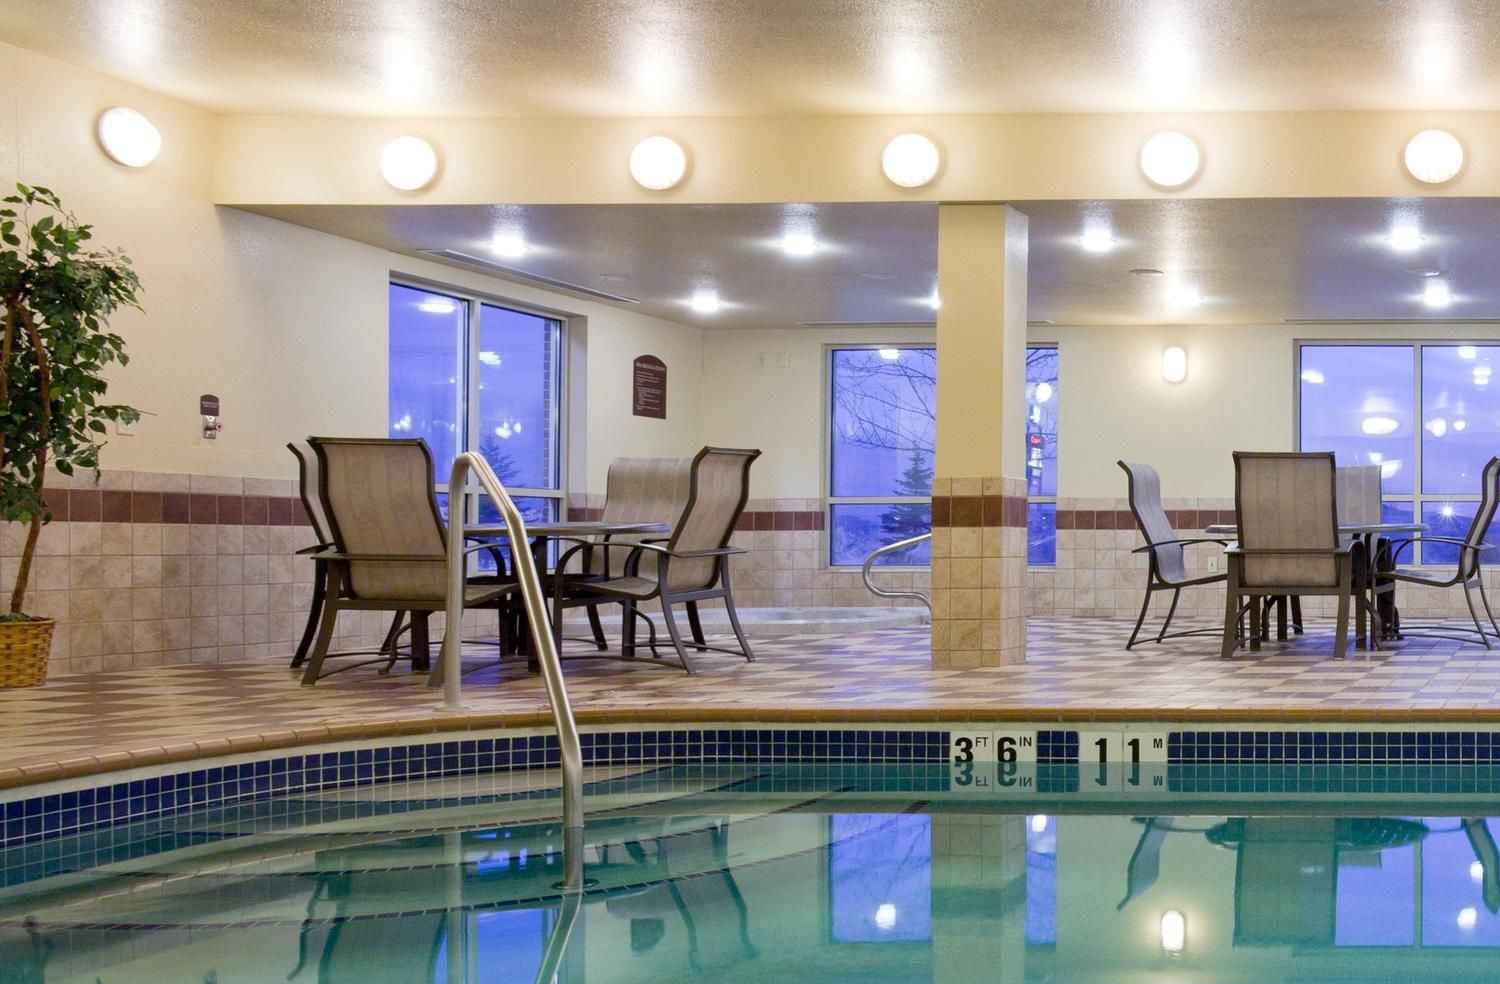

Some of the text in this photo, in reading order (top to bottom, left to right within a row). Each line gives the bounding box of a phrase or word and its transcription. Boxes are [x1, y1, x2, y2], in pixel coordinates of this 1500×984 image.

[954, 736, 1032, 762] 3 FT 6 IN
[1153, 738, 1163, 749] M
